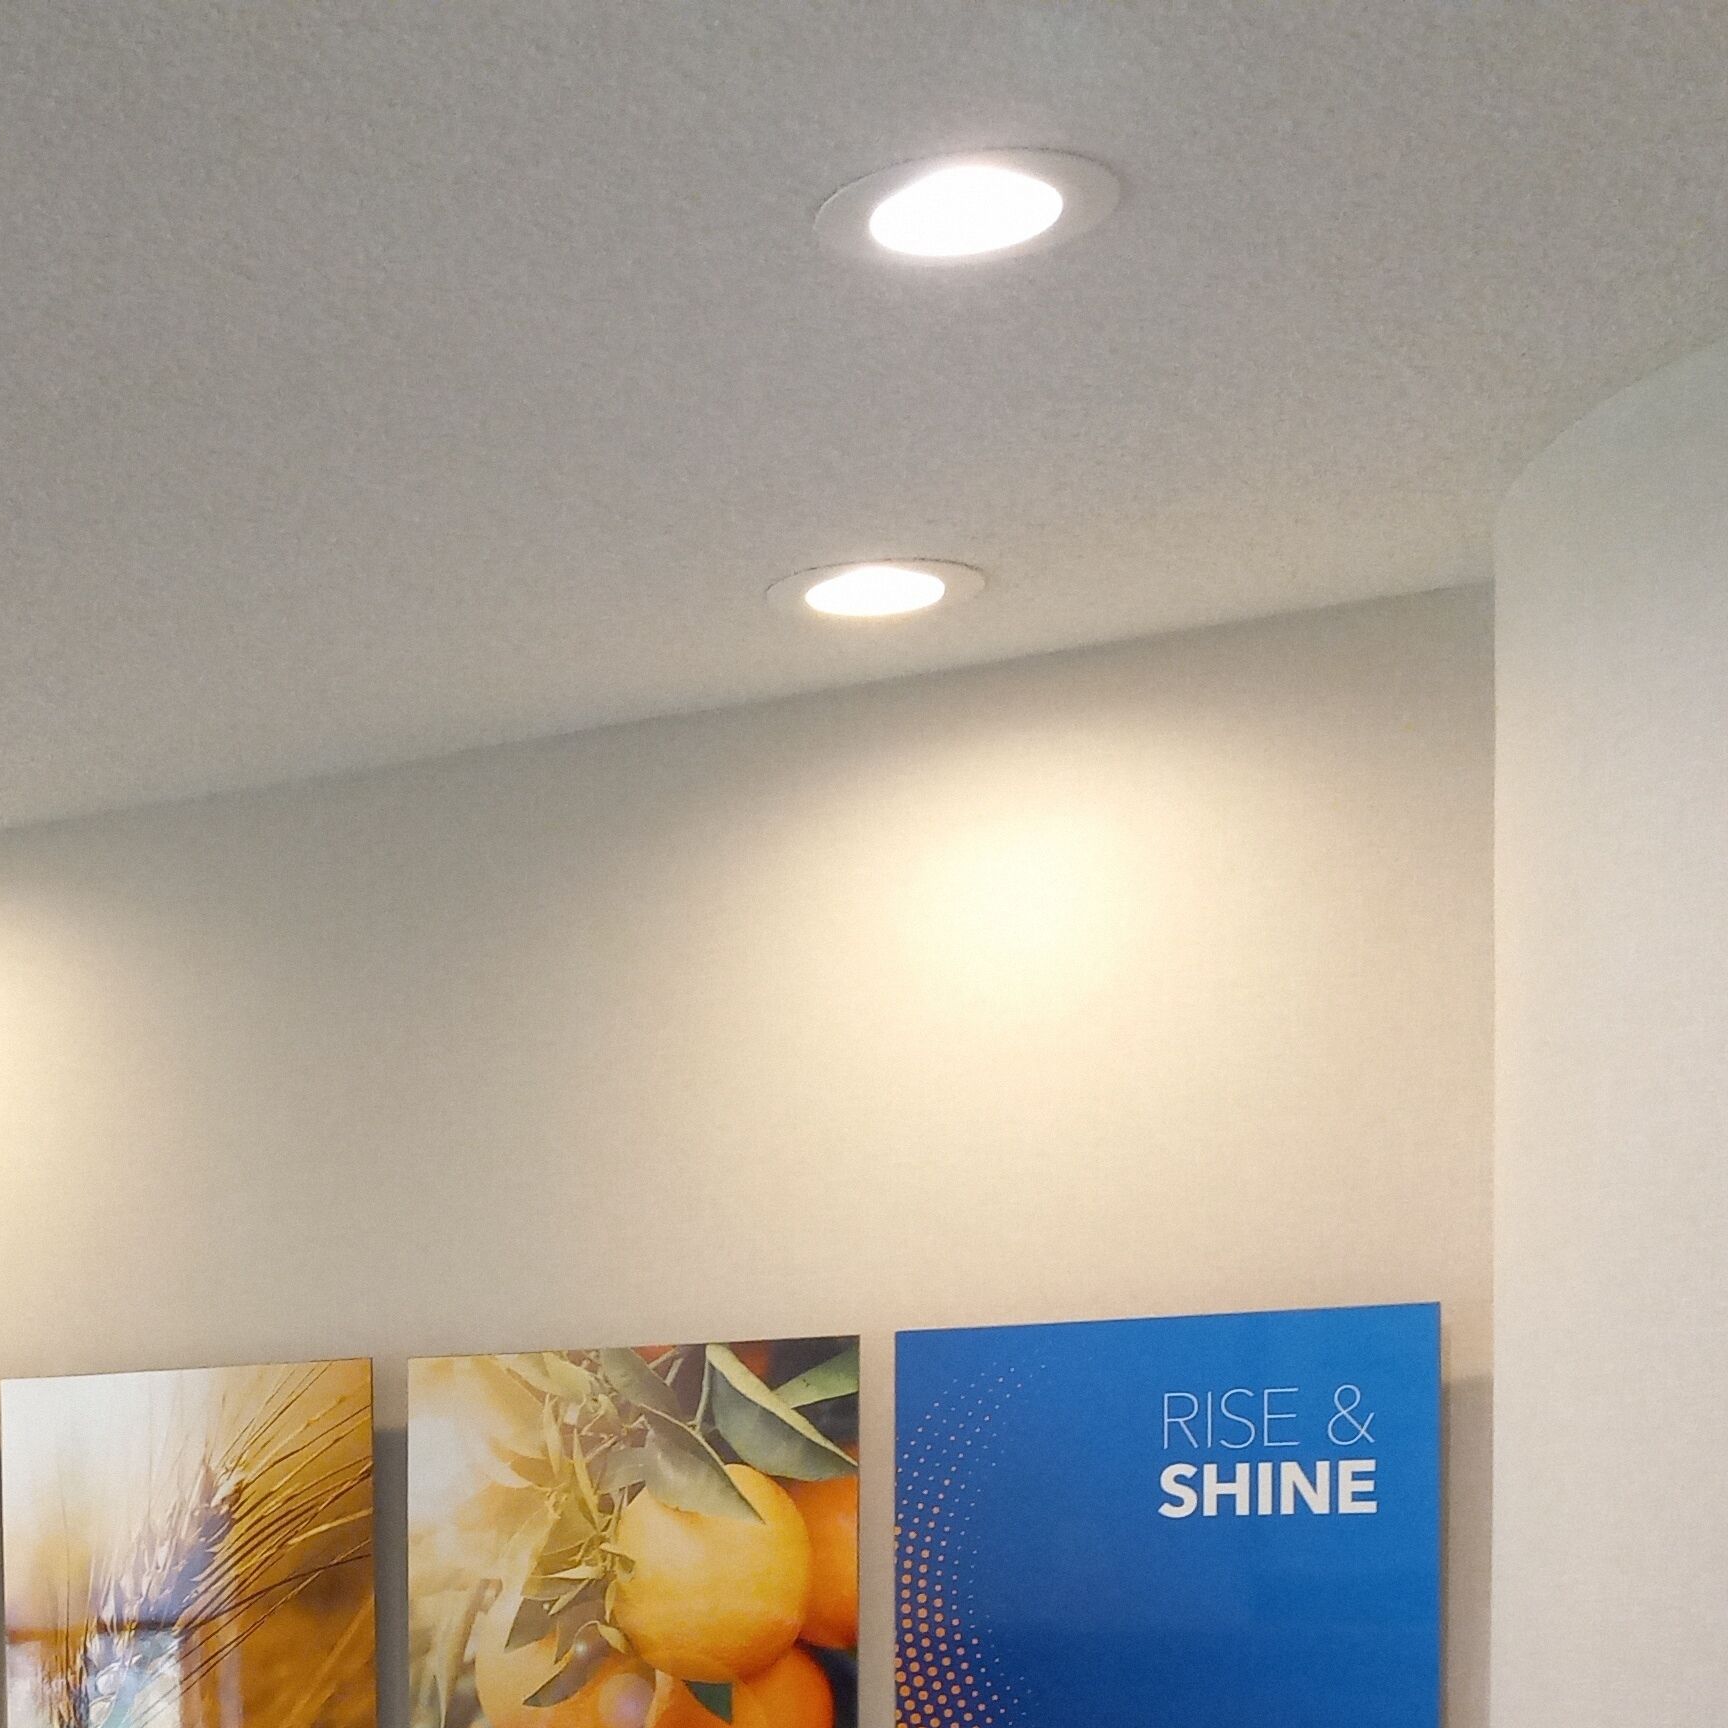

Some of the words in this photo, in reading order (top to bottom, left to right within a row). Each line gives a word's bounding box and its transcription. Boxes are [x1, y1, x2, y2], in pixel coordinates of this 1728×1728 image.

[1163, 1387, 1301, 1450] RISE
[1327, 1384, 1376, 1446] &
[1157, 1458, 1378, 1519] SHINE
